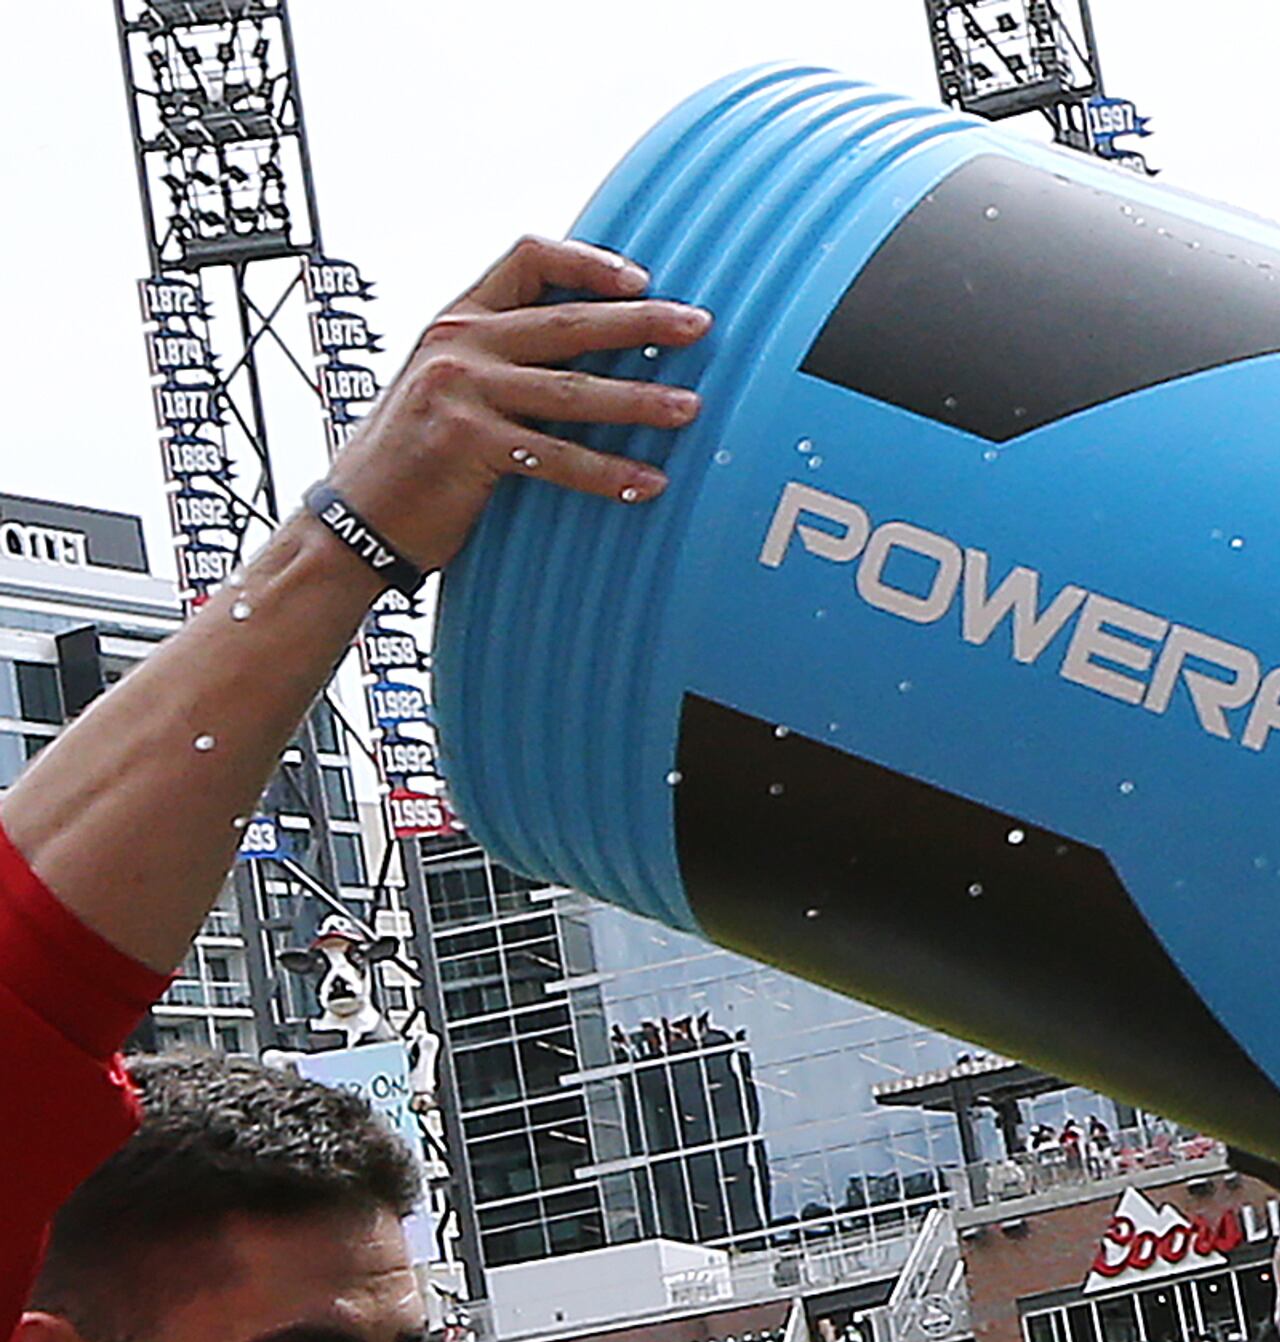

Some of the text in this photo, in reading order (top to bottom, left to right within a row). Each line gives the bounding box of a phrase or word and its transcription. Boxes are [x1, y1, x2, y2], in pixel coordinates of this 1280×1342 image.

[1089, 104, 1135, 132] 1997
[309, 265, 359, 295] 1873
[147, 284, 196, 313] 1872
[317, 318, 368, 347] 1875
[325, 370, 376, 399] 1878
[161, 388, 210, 420] 1877
[176, 497, 230, 526] 1892
[321, 501, 396, 568] ALIVE
[185, 552, 235, 580] 1897
[373, 690, 427, 719] 1982
[382, 744, 435, 772] 1992
[390, 798, 444, 828] 1995
[1092, 1208, 1243, 1278] Coors
